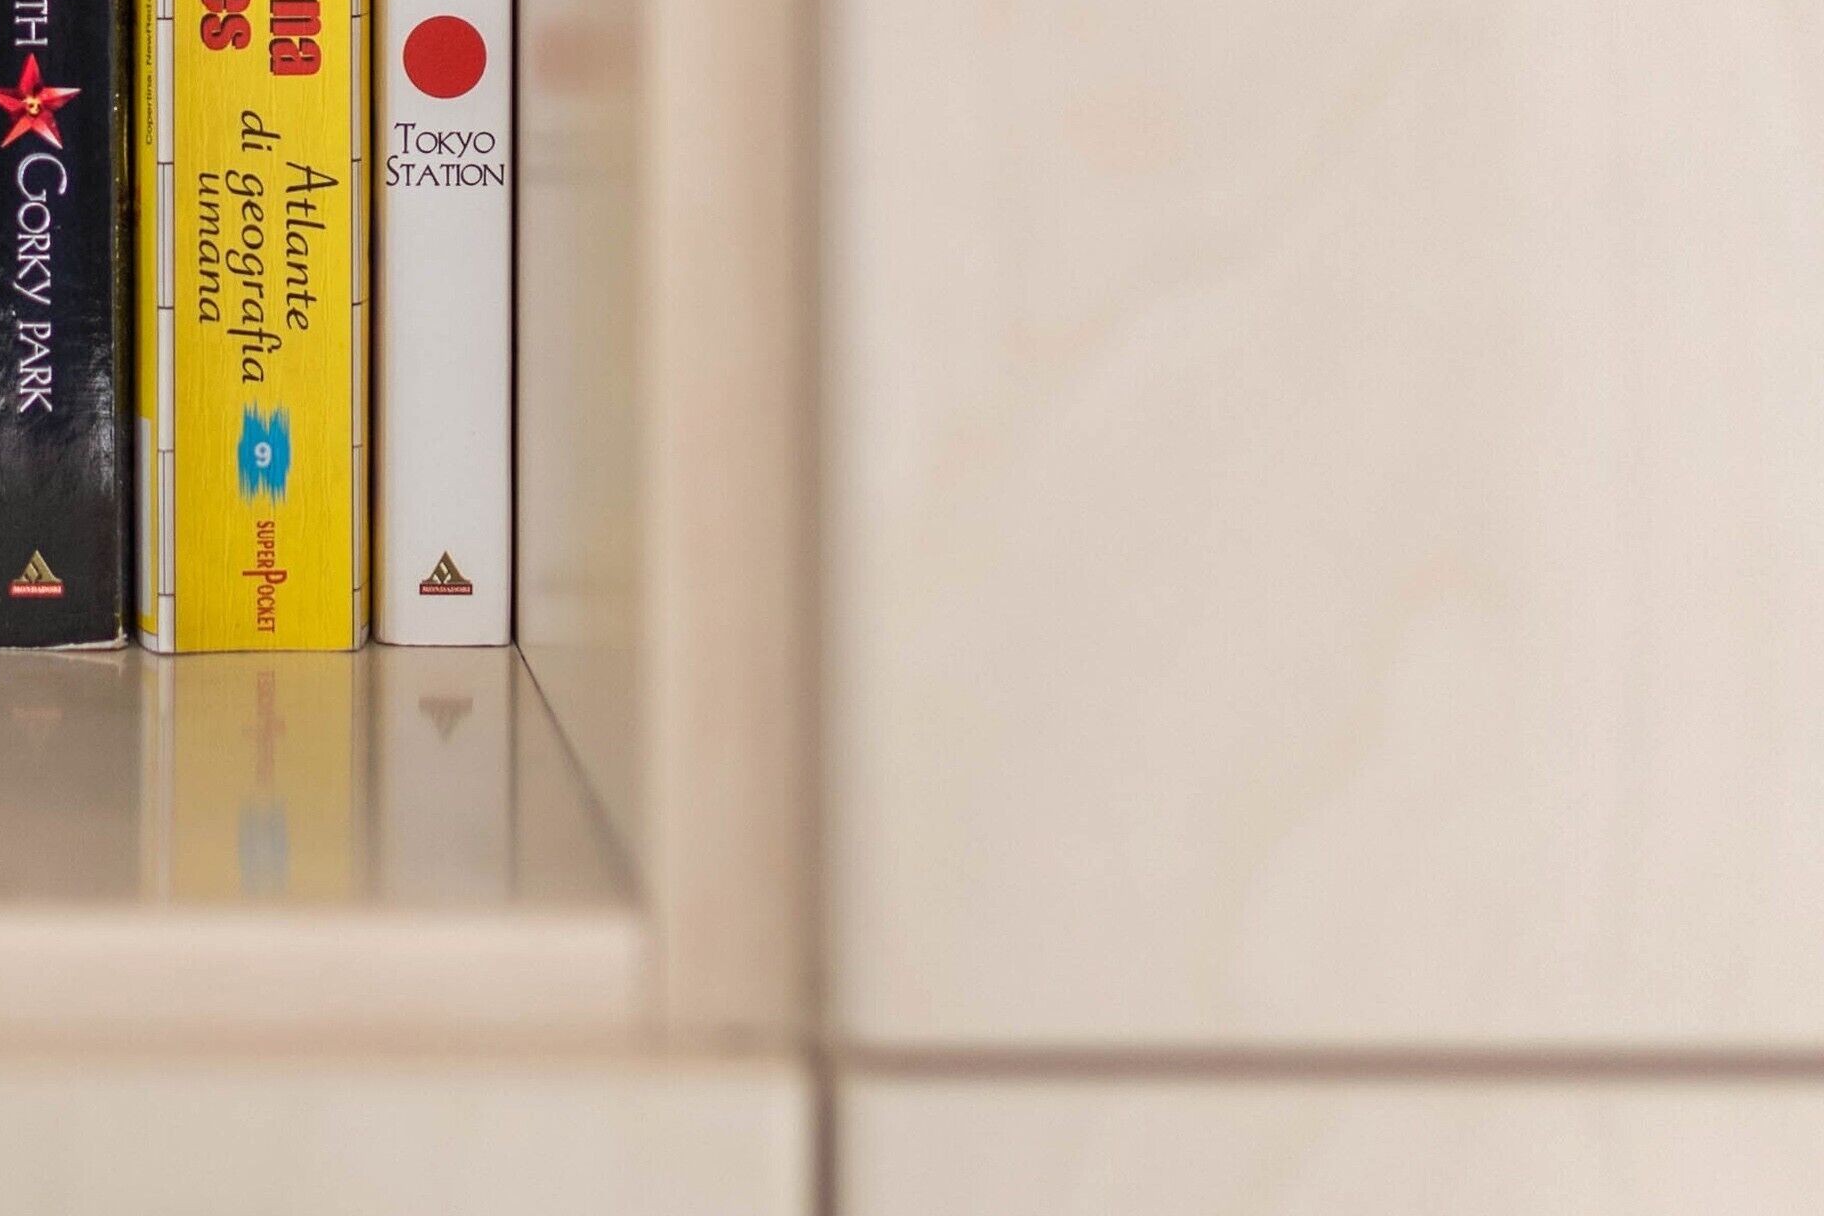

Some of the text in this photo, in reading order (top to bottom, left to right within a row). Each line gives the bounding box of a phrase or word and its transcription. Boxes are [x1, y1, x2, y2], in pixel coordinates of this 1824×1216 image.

[385, 155, 505, 187] STATION
[393, 122, 496, 158] TOKYO
[12, 152, 68, 414] GORKY PARK
[198, 170, 222, 325] umana
[226, 110, 282, 384] di geografia
[285, 160, 339, 332] Atlante
[12, 585, 62, 594] MONDADORI
